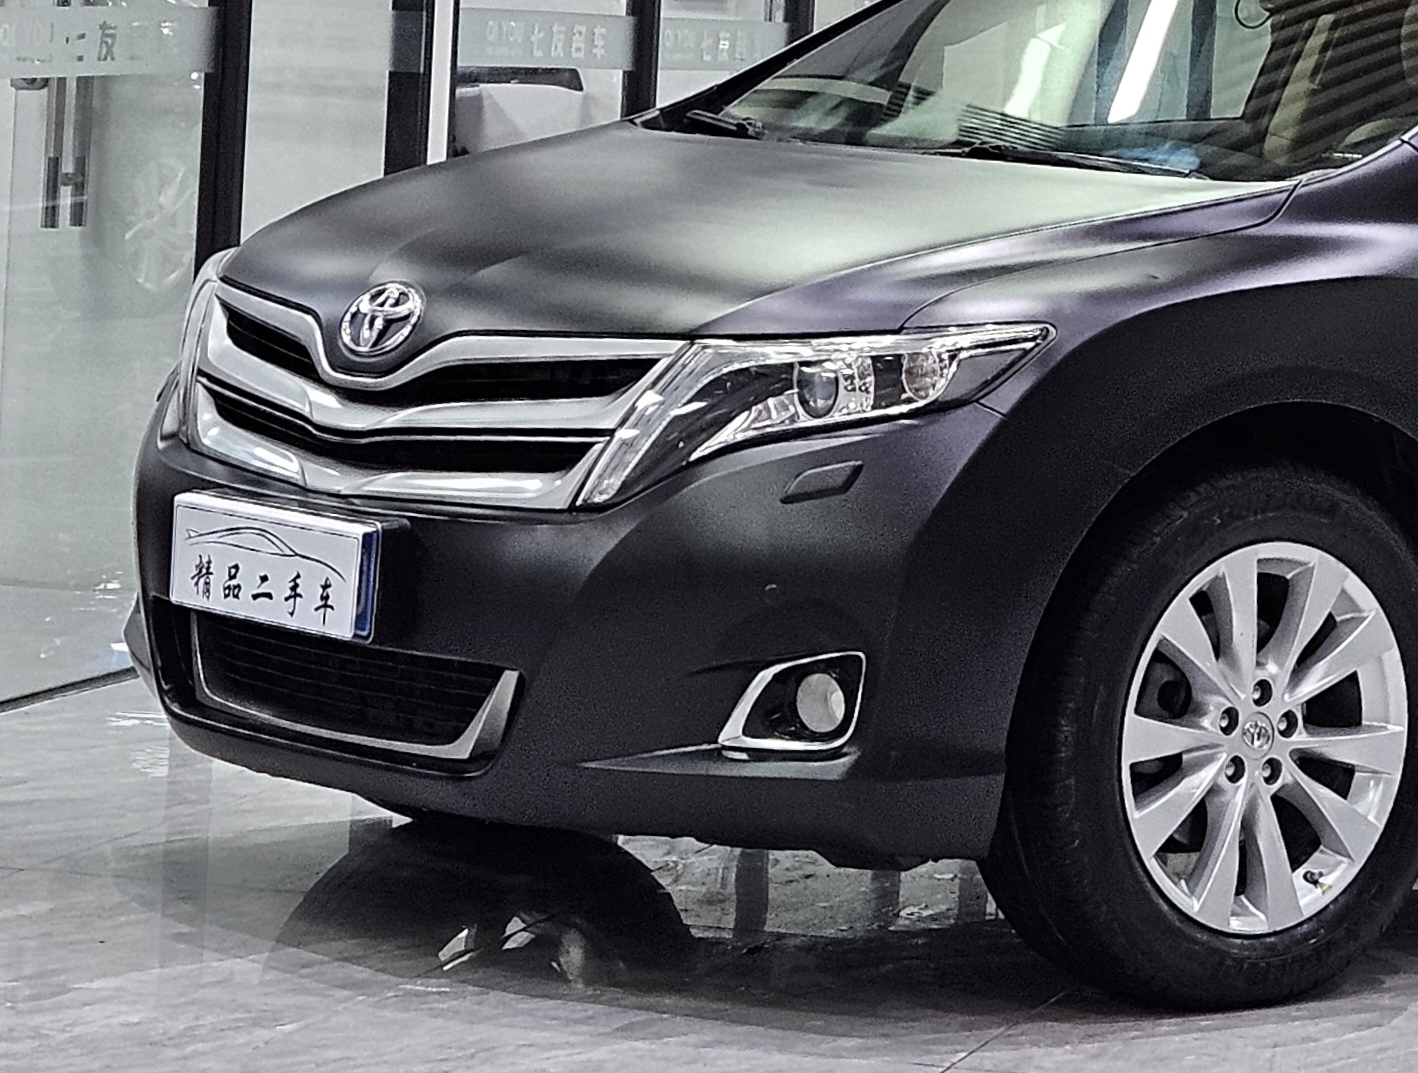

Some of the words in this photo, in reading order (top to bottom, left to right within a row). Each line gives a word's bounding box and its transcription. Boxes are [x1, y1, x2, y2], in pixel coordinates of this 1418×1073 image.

[190, 553, 336, 627] 精品二手车
